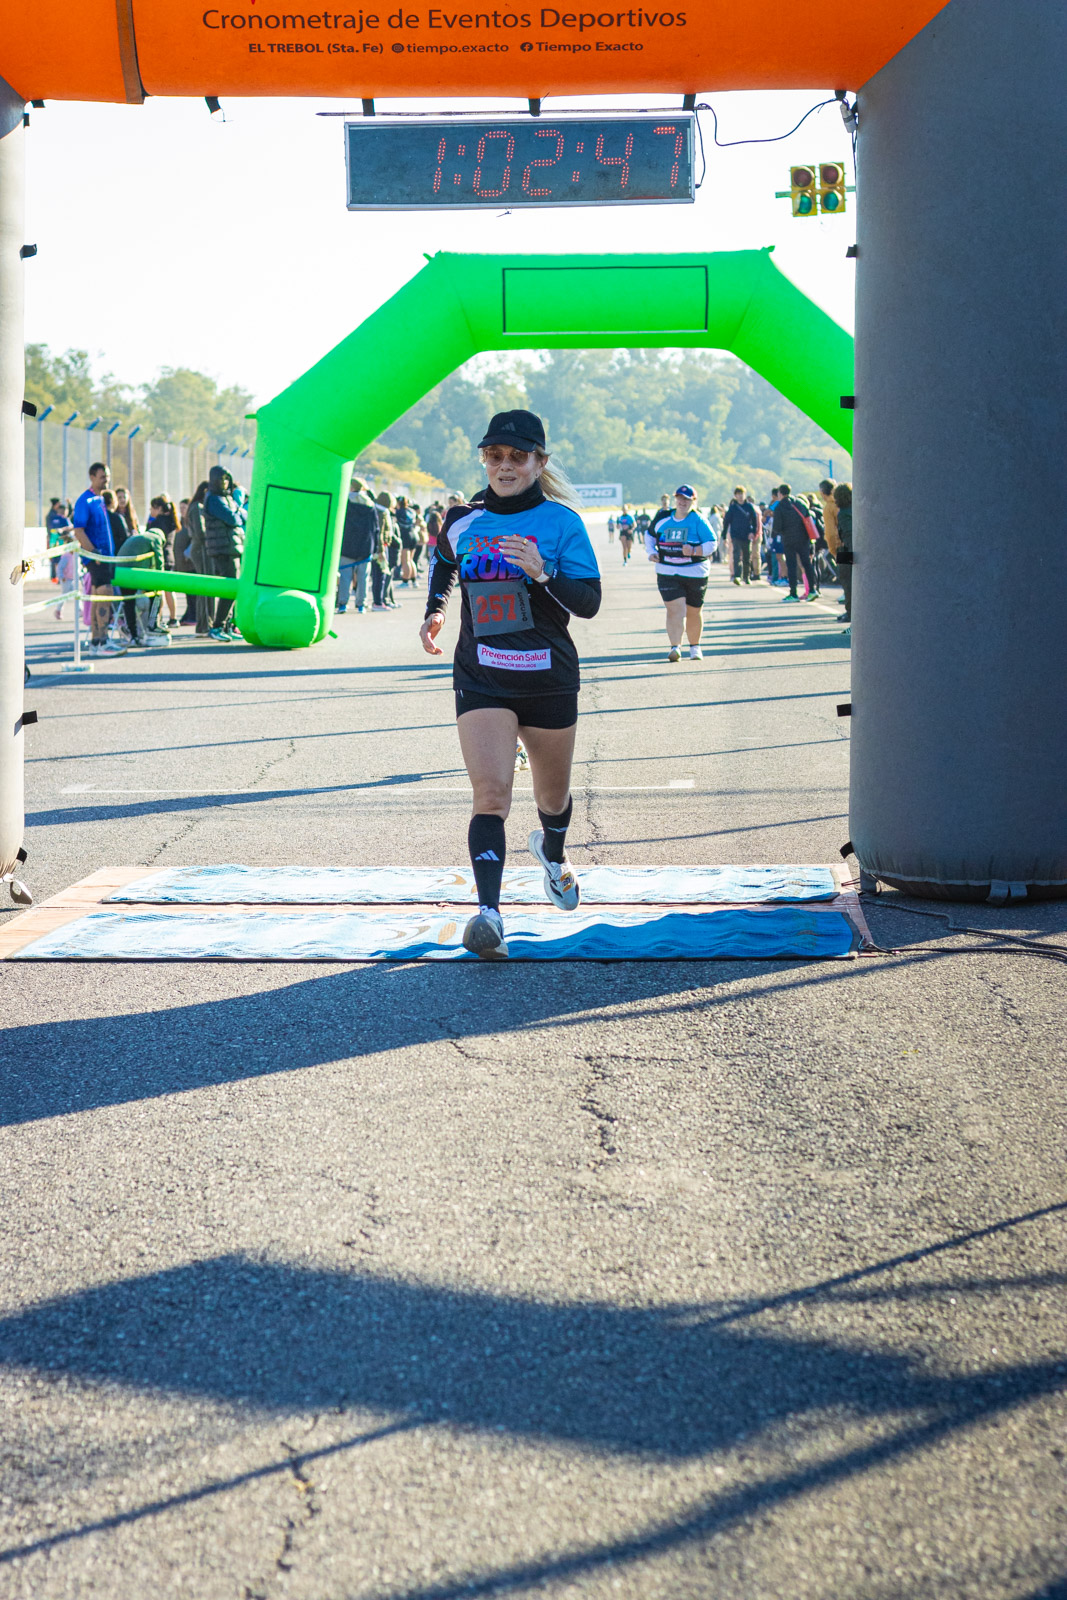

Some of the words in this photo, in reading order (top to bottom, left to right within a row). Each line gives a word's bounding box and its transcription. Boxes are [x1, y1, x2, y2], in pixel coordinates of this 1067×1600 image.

[202, 9, 380, 34] Cronometraje
[387, 8, 420, 29] de
[428, 9, 532, 29] Eventos
[540, 8, 687, 32] Deportivos
[248, 43, 265, 53] EL
[267, 43, 324, 53] TREBOL
[327, 43, 359, 54] (Sta.
[362, 43, 384, 54] Fe)
[406, 43, 510, 55] tiempo.exacto
[535, 41, 592, 54] Tiempo
[595, 41, 644, 52] Exacto
[433, 126, 683, 197] 1:02:47
[671, 530, 682, 540] 12
[475, 594, 517, 624] 257
[481, 647, 525, 661] Prevención
[525, 651, 547, 662] Salud
